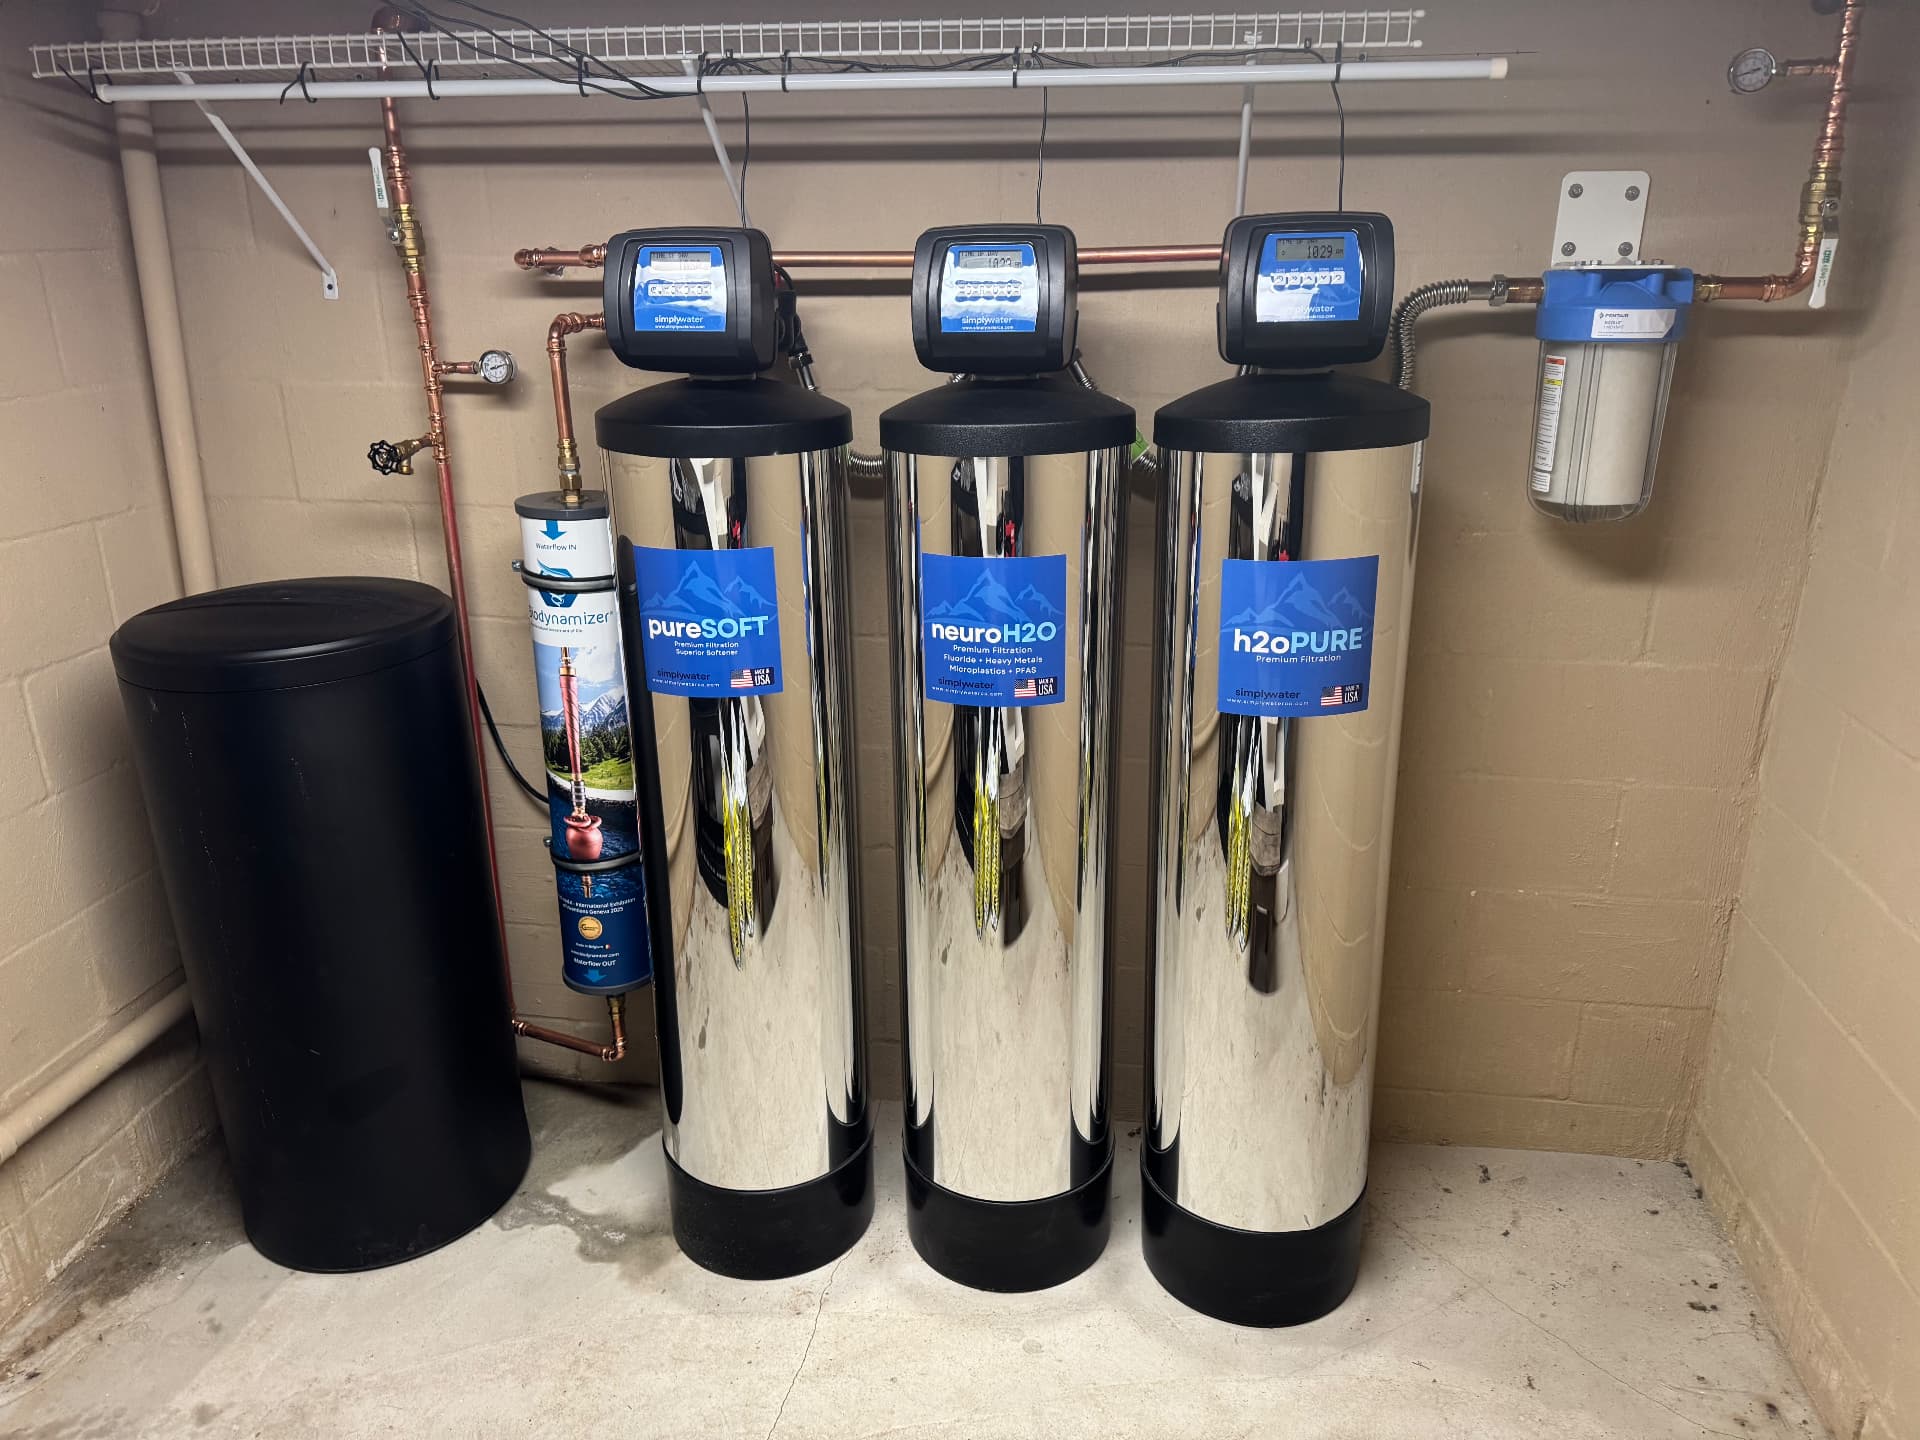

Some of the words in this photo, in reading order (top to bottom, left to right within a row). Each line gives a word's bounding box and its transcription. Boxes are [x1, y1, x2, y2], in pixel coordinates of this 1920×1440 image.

[1307, 245, 1332, 258] 1029
[654, 315, 704, 324] simplywater
[961, 315, 1012, 325] simplywater
[536, 543, 567, 551] Waterflow
[648, 615, 769, 640] pureSOFT
[931, 621, 1057, 644] neuroH2O
[674, 640, 704, 648] Premium
[1233, 627, 1363, 655] h2oPURE
[675, 648, 704, 656] Superior
[953, 644, 990, 654] Premium
[992, 646, 1032, 654] Filtration
[943, 653, 976, 664] Fluoride
[985, 657, 1012, 666] Heavy
[1014, 656, 1043, 664] Metals
[1256, 655, 1298, 663] Premium
[1300, 654, 1341, 663] Filtration
[657, 668, 710, 681] simplywater
[949, 665, 1006, 675] Microplastics
[1015, 666, 1037, 674] PFAS
[755, 674, 771, 686] USA
[938, 676, 994, 690] simplywater
[1038, 684, 1054, 696] USA
[1235, 687, 1301, 700] simplywater
[1344, 690, 1359, 703] USA
[609, 897, 636, 907] Exhibition
[573, 957, 601, 967] Waterflow
